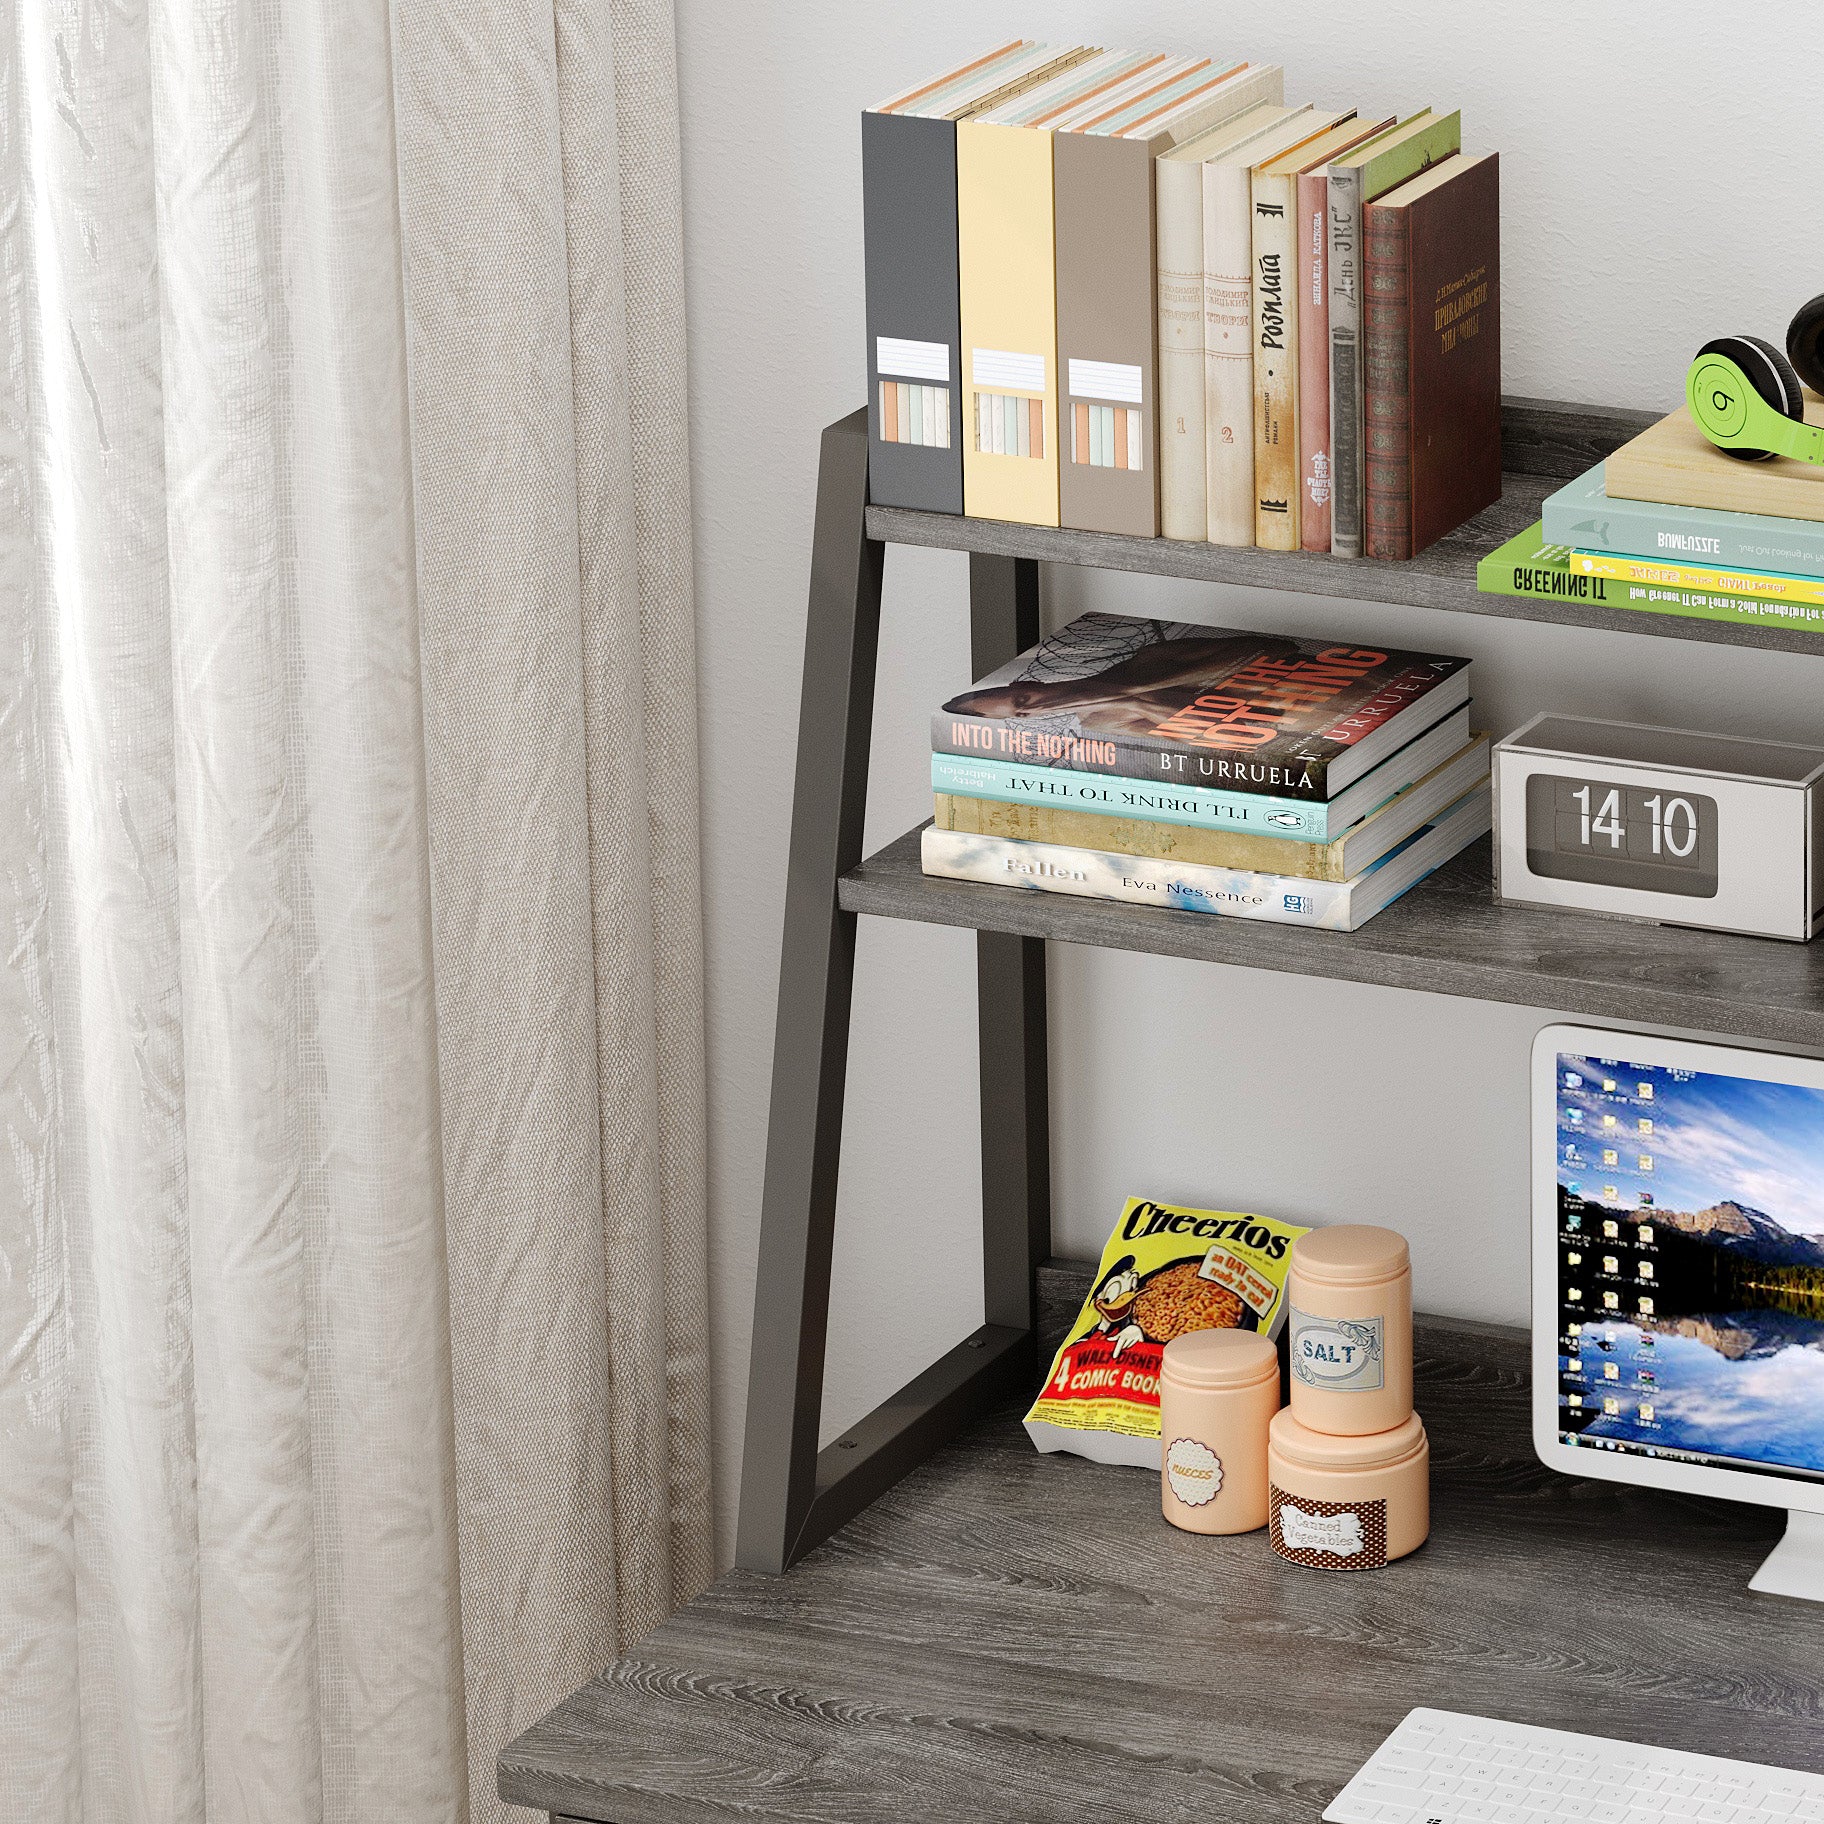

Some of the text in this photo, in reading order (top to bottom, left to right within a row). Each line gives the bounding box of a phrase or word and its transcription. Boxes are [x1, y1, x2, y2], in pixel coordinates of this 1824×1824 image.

[1206, 312, 1249, 326] ТВОРИ
[1176, 416, 1186, 433] 1
[1221, 426, 1234, 443] 2
[1148, 695, 1248, 740] INTO
[1214, 655, 1309, 691] THE
[1188, 648, 1388, 752] NOTHING
[1322, 659, 1454, 742] URRUELA
[952, 722, 1116, 766] INTO THE NOTHING
[939, 766, 996, 781] Halbreich
[952, 775, 984, 788] Betty
[1160, 752, 1314, 789] BT URRUELA
[1006, 778, 1250, 820] I'LL DRINK TO THAT
[1572, 785, 1698, 858] 14 10
[1003, 858, 1087, 882] Fallen
[1122, 877, 1264, 906] Eva Nessence
[1285, 895, 1301, 912] HG
[1122, 1201, 1291, 1260] Cheerios
[1225, 1256, 1249, 1276] OAT
[1302, 1338, 1358, 1365] SALT
[1054, 1356, 1072, 1393] 4
[1070, 1368, 1121, 1391] COMIC
[1288, 1525, 1354, 1546] Vegetables
[1295, 1513, 1342, 1532] Canned
